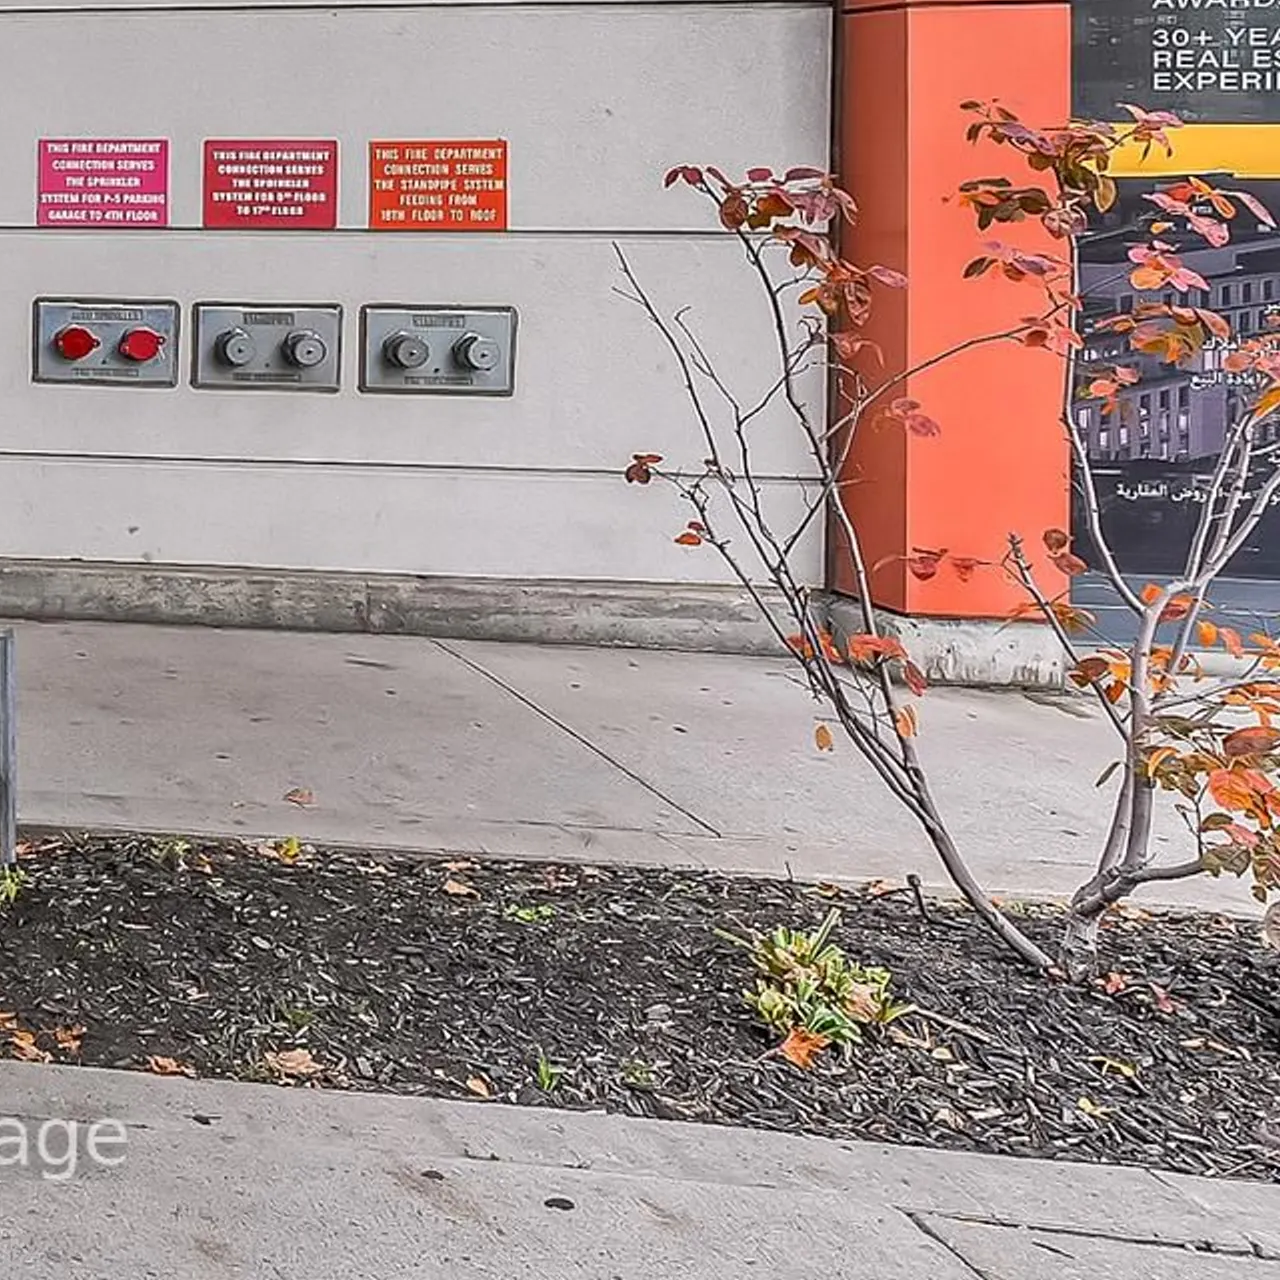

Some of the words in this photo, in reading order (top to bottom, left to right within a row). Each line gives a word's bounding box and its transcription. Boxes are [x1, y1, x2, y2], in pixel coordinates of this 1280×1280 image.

[1152, 28, 1213, 48] 30+
[1153, 49, 1240, 69] REAL
[1153, 71, 1280, 91] EXPERI
[48, 142, 70, 153] THIS
[71, 142, 94, 153] FIRE
[96, 142, 161, 153] DEPARTMENT
[213, 151, 237, 160] THIS
[239, 151, 260, 160] FIRE
[262, 151, 330, 160] DEPARTMENT
[376, 149, 399, 160] THIS
[405, 149, 428, 160] FIRE
[434, 149, 503, 160] DEPARTMENT
[52, 159, 115, 170] CONNECTION
[117, 159, 156, 170] SERVES
[218, 164, 283, 175] CONNECTION
[285, 164, 325, 175] SERVES
[384, 164, 449, 175] CONNECTION
[455, 164, 493, 175] SERVES
[66, 176, 85, 187] THE
[87, 176, 141, 187] SPRINKLER
[232, 179, 251, 188] THE
[253, 179, 309, 188] SPRINKLER
[374, 179, 394, 190] THE
[400, 179, 457, 190] STANDPIPE
[464, 179, 504, 190] SYSTEM
[41, 193, 80, 204] SYSTEM
[82, 193, 101, 204] FOR
[123, 193, 166, 204] PARKING
[212, 192, 253, 202] SYSTEM
[255, 192, 274, 202] FOR
[294, 192, 326, 202] FLOOR
[400, 194, 443, 205] FEEDING
[449, 194, 477, 205] FROM
[48, 210, 86, 221] GARAGE
[88, 210, 102, 221] TO
[126, 210, 158, 221] FLOOR
[237, 206, 251, 216] TO
[412, 210, 443, 221] FLOOR
[450, 210, 463, 221] TO
